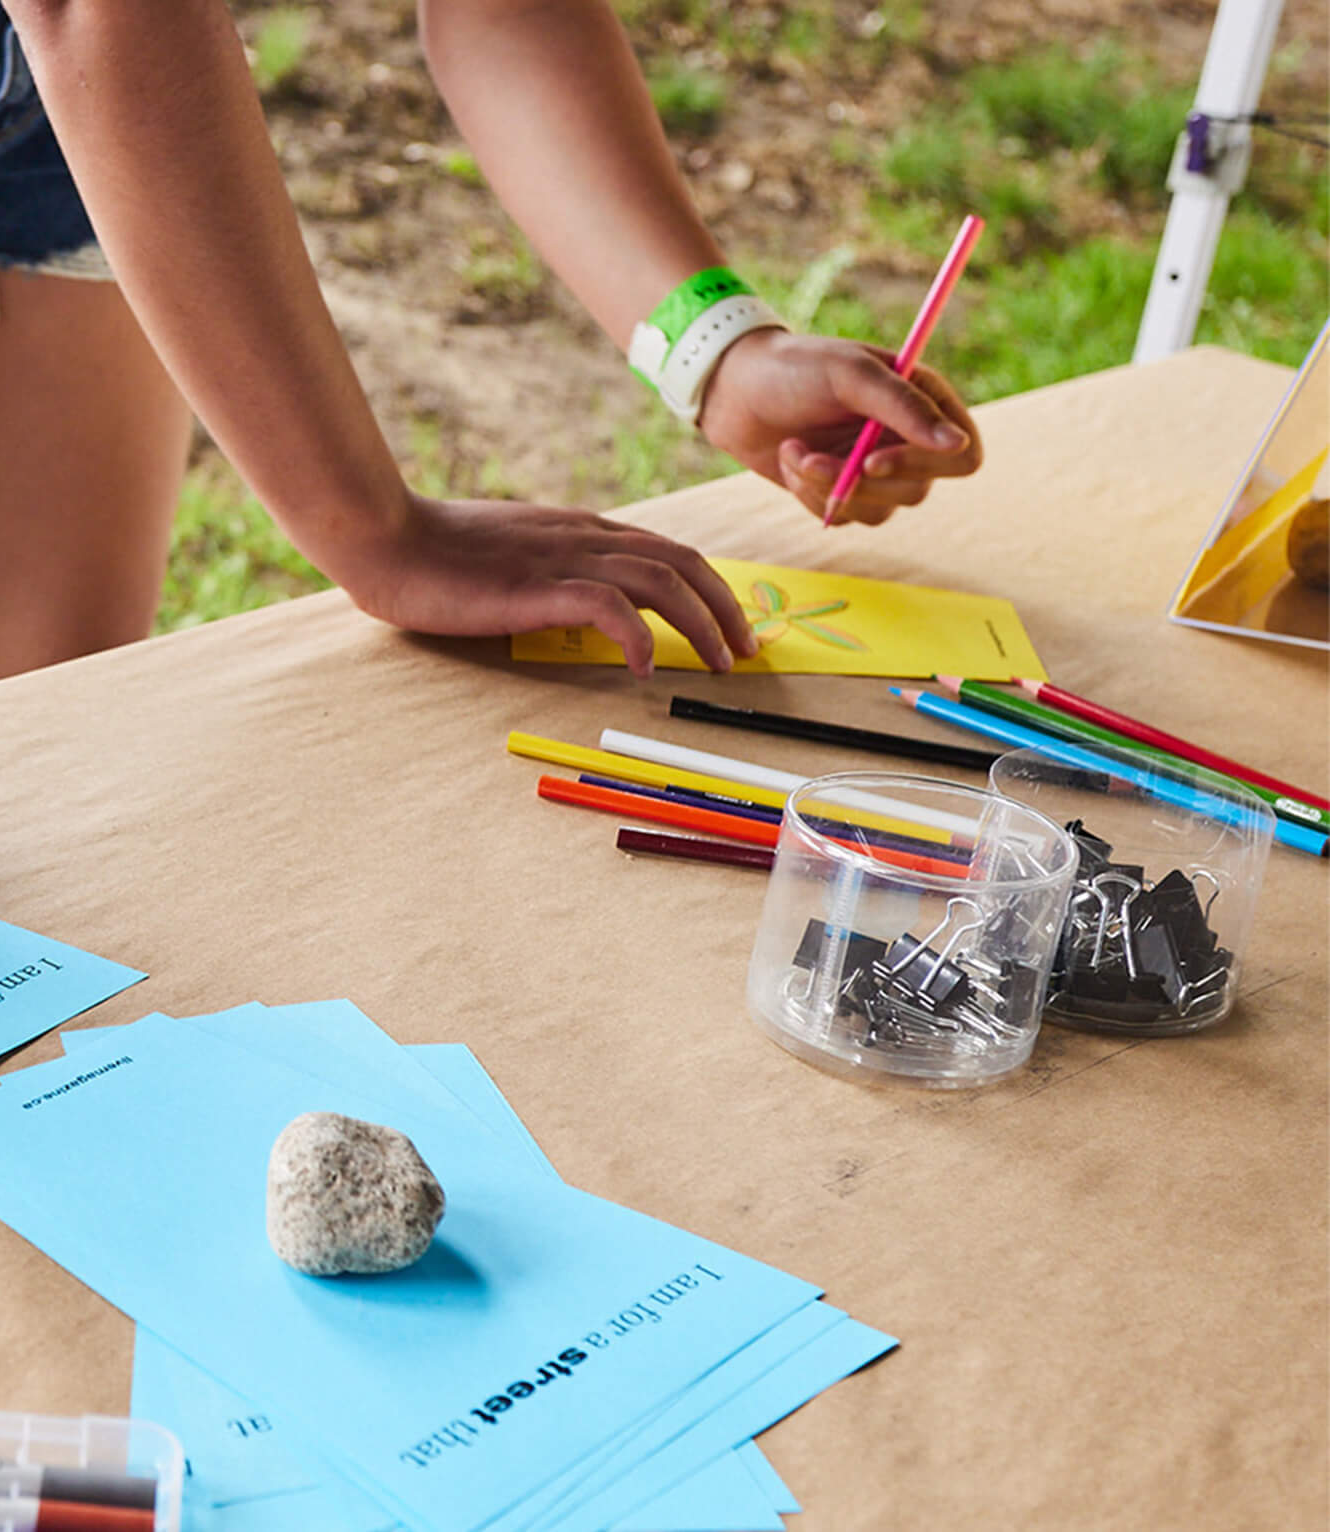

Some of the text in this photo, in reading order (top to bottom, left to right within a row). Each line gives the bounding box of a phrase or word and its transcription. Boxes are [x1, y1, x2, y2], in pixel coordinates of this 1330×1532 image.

[40, 957, 64, 971] I
[21, 1055, 134, 1110] livemagazine.ca
[398, 1263, 725, 1469] I am for a street that
